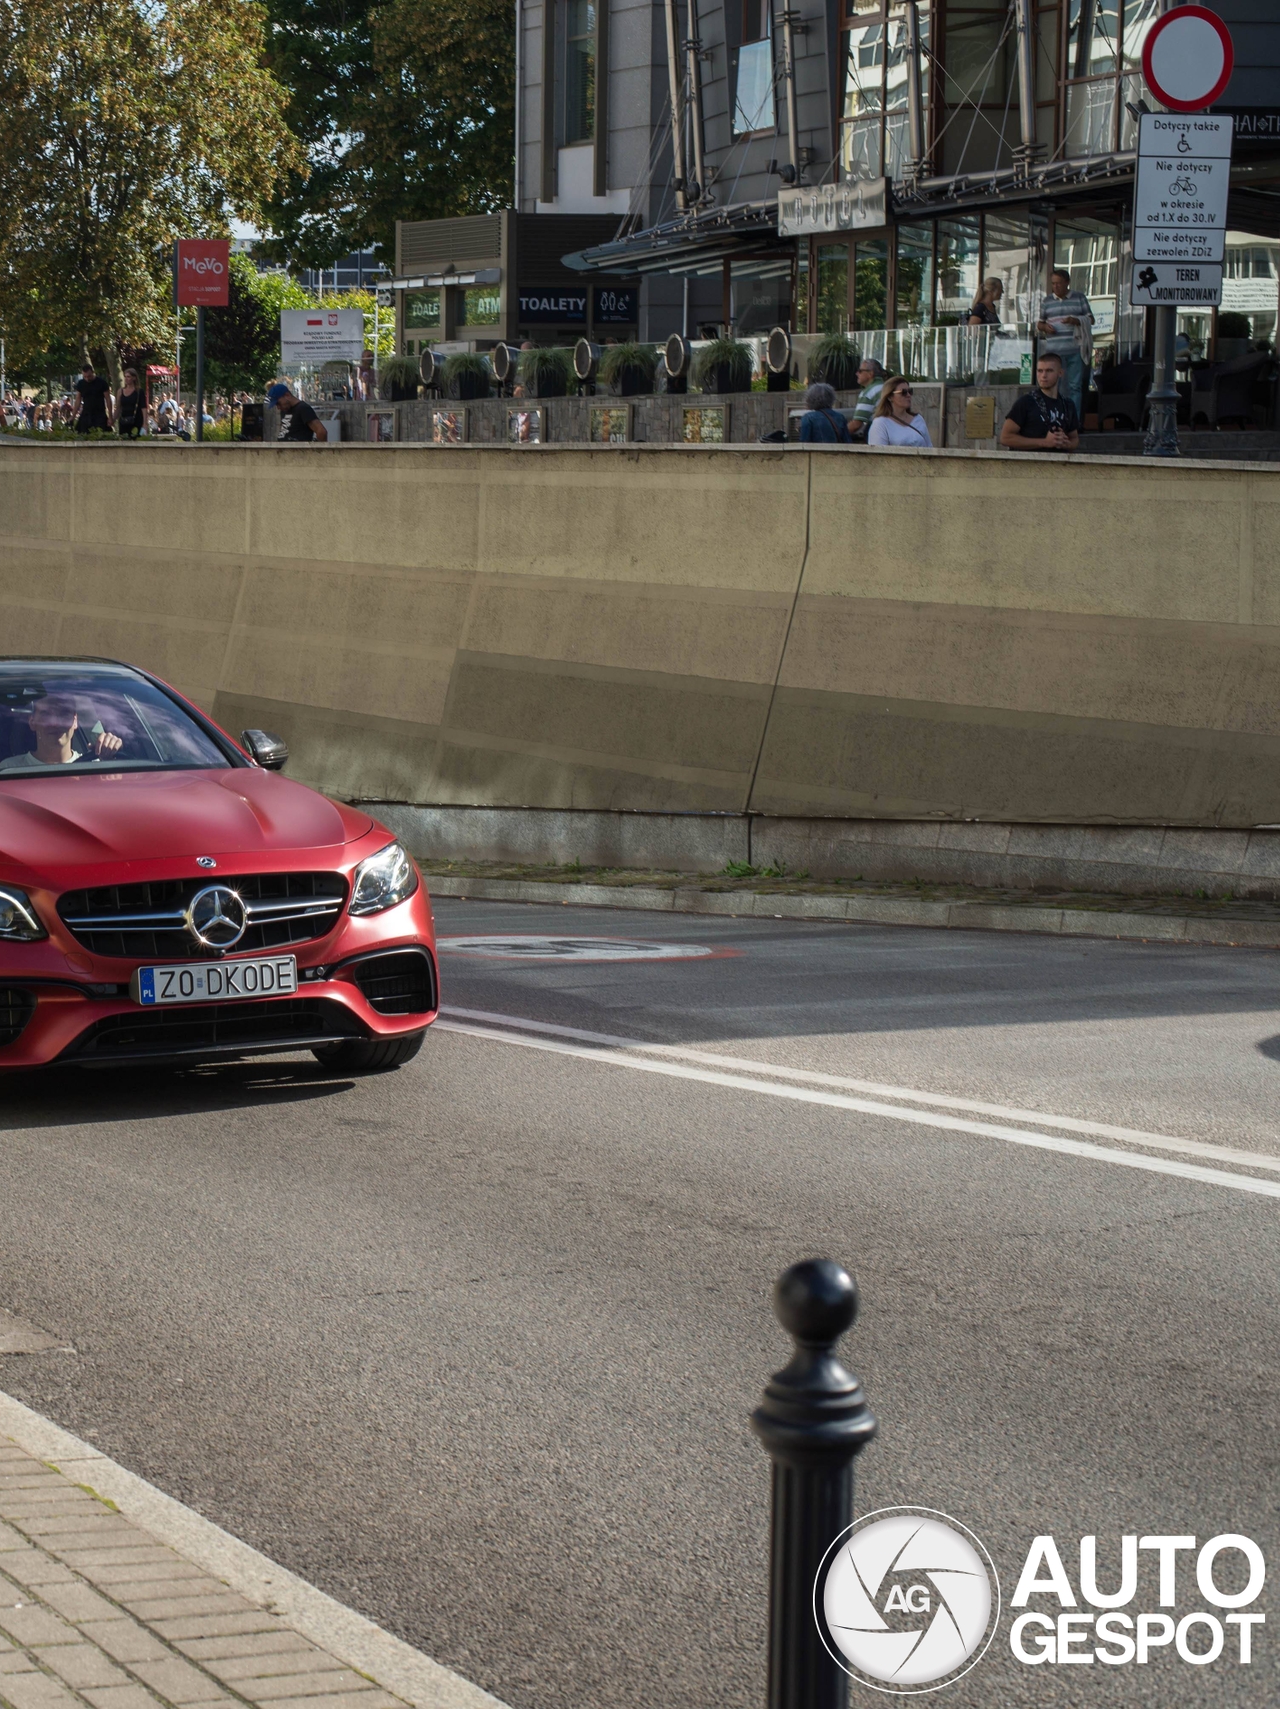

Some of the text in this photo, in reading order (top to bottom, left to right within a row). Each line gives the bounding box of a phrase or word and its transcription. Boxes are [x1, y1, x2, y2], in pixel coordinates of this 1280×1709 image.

[1154, 119, 1220, 133] Dotyczy także
[1156, 161, 1213, 175] Nie dotyczy
[794, 189, 867, 226] HOTEL
[1160, 199, 1205, 209] w okresie
[1147, 213, 1216, 223] od 1.X do 30.IV
[1153, 232, 1208, 246] Nie dotyczy
[1147, 246, 1212, 257] zezwoleń ZDiZ
[1176, 268, 1200, 282] TEREN
[1155, 286, 1218, 301] MONITOROWANY
[477, 297, 500, 315] ATM
[521, 297, 586, 311] TOALETY
[143, 989, 154, 998] PL
[207, 962, 292, 995] DKODE
